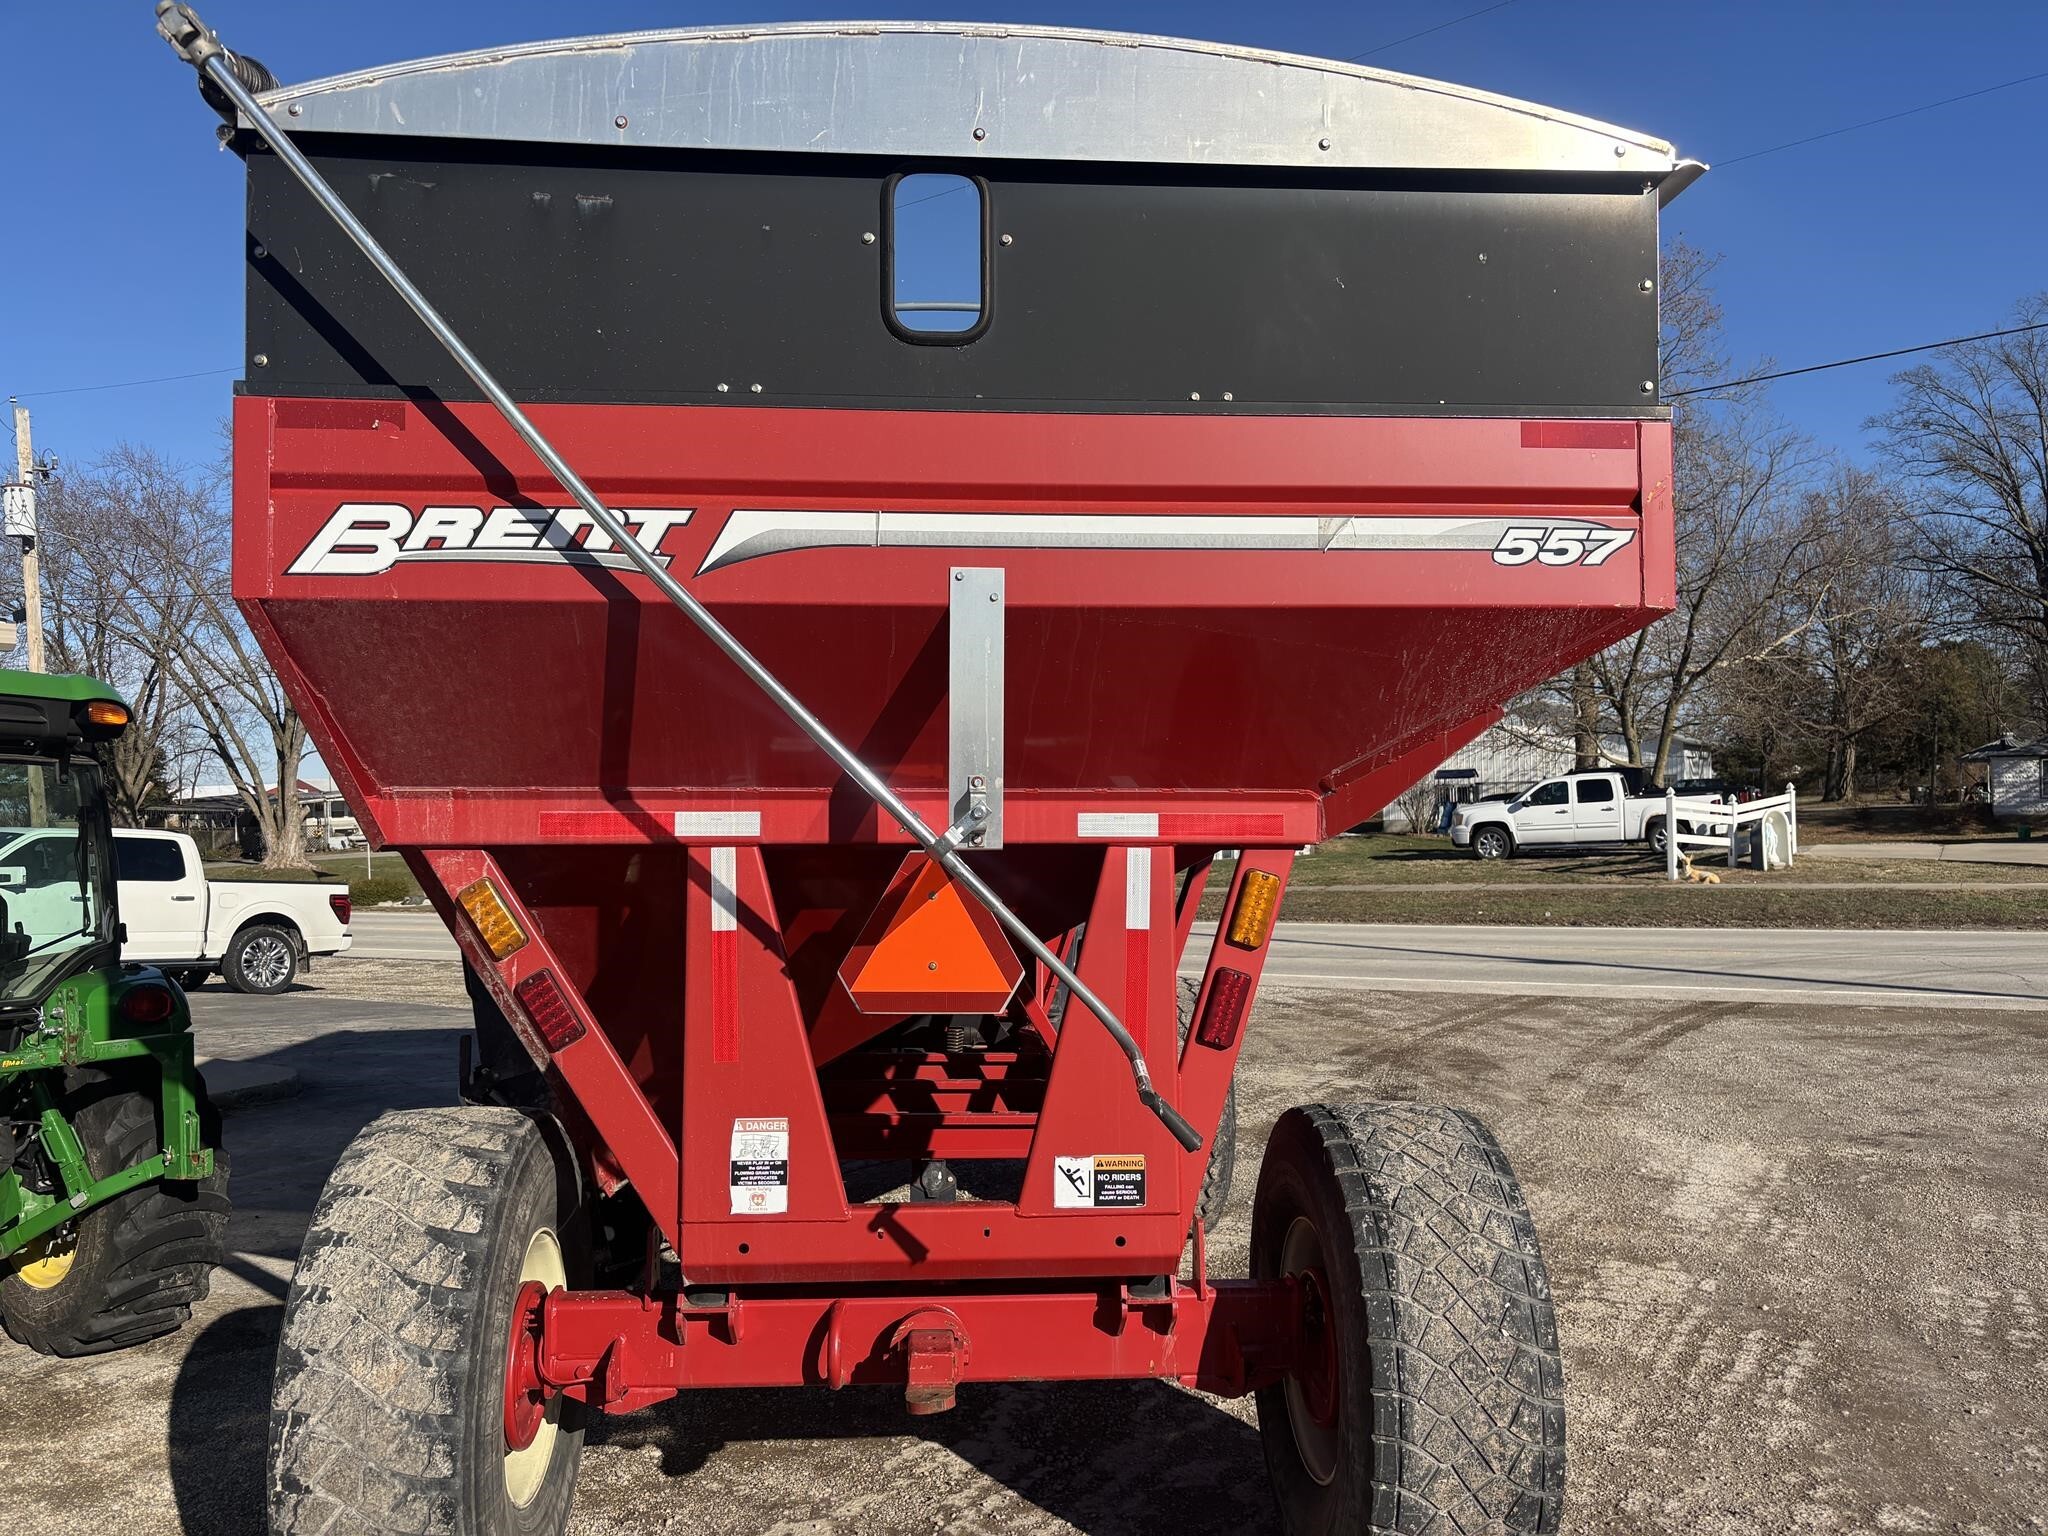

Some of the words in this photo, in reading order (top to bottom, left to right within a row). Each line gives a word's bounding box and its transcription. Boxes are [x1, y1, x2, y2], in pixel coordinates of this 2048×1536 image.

[282, 502, 695, 575] BRENT
[1491, 526, 1637, 566] 557
[746, 1121, 787, 1131] DANGER
